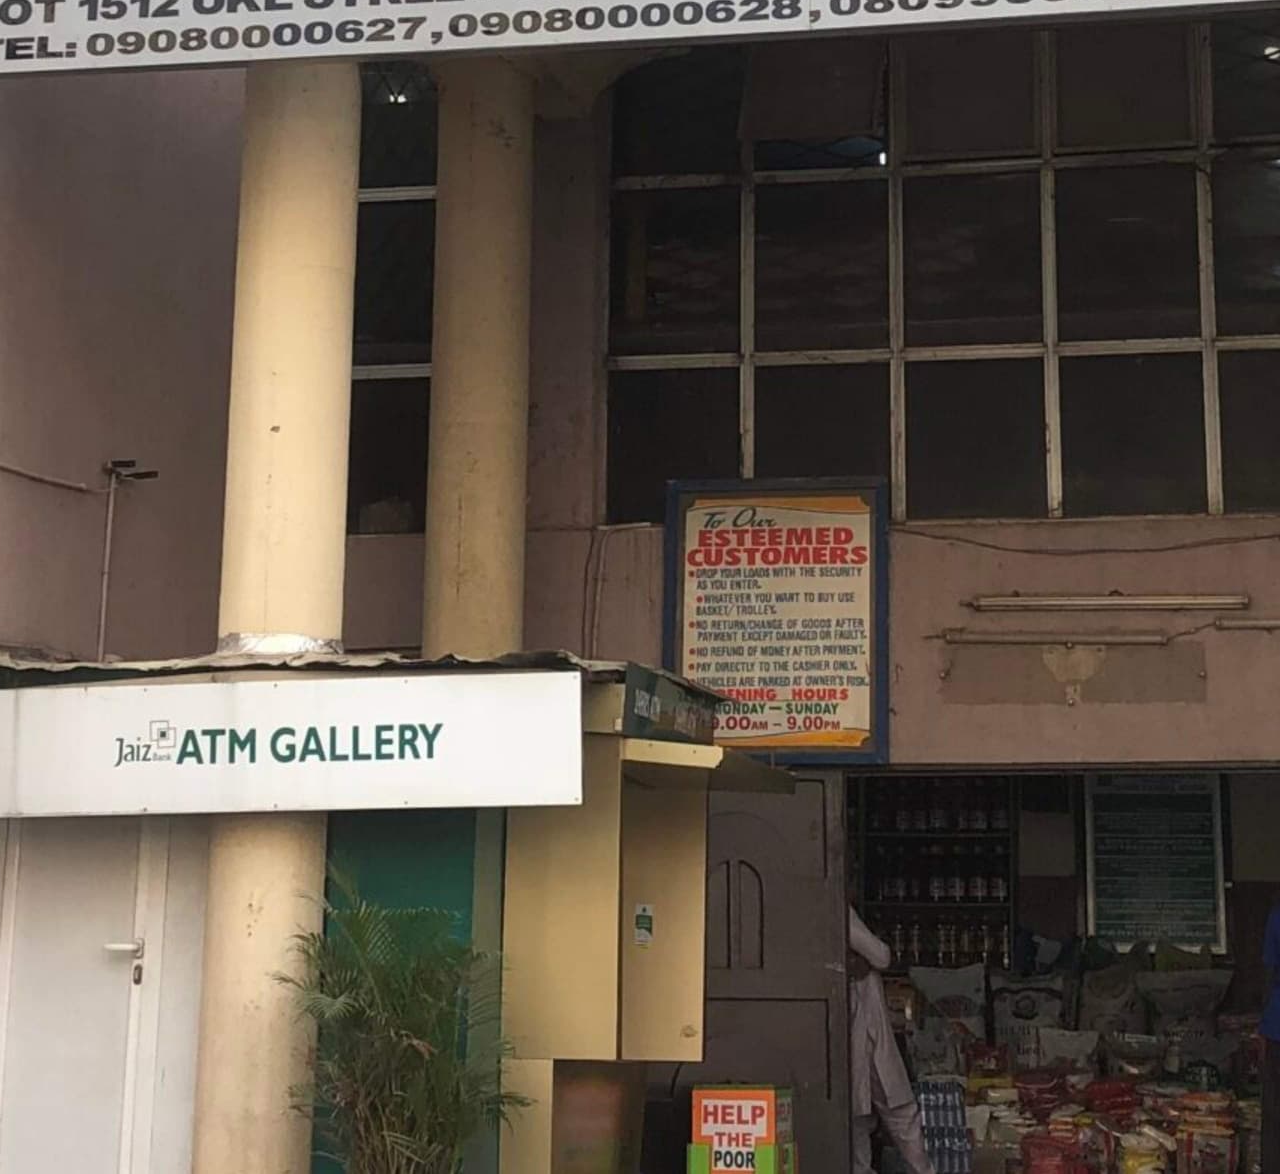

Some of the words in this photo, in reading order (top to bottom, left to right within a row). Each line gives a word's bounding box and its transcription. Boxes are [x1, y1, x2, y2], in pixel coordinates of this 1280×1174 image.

[704, 511, 726, 529] To
[732, 507, 777, 528] Our
[698, 527, 854, 548] ESTEEMED
[687, 545, 868, 567] CUSTOMERS
[720, 568, 741, 578] YOUR
[772, 567, 796, 578] WITH
[800, 566, 816, 577] THE
[819, 566, 863, 577] SECURITY
[696, 579, 708, 590] AS
[710, 579, 727, 589] YOU
[730, 579, 762, 589] ENTER.
[704, 593, 752, 603] WHATEVER
[755, 592, 772, 603] YOU
[775, 592, 800, 602] WANT
[803, 592, 815, 602] TO
[838, 591, 856, 602] USE
[786, 618, 798, 629] OF
[836, 618, 864, 628] AFTER
[697, 631, 737, 641] PAYMENT
[747, 646, 757, 656] OF
[761, 645, 790, 656] MONEY
[792, 645, 820, 655] AFTER
[696, 662, 711, 673] PAY
[759, 661, 770, 672] TO
[773, 661, 789, 671] THE
[740, 676, 754, 686] ARE
[792, 675, 802, 686] AT
[792, 688, 849, 701] HOURS
[785, 702, 839, 715] SUNDAY
[786, 715, 841, 731] 9.00PM
[114, 736, 151, 767] Jaiz
[176, 728, 257, 765] ATM
[270, 723, 443, 763] GALLERY
[703, 1104, 765, 1125] HELP
[715, 1132, 753, 1148] THE
[714, 1150, 755, 1168] POOR
